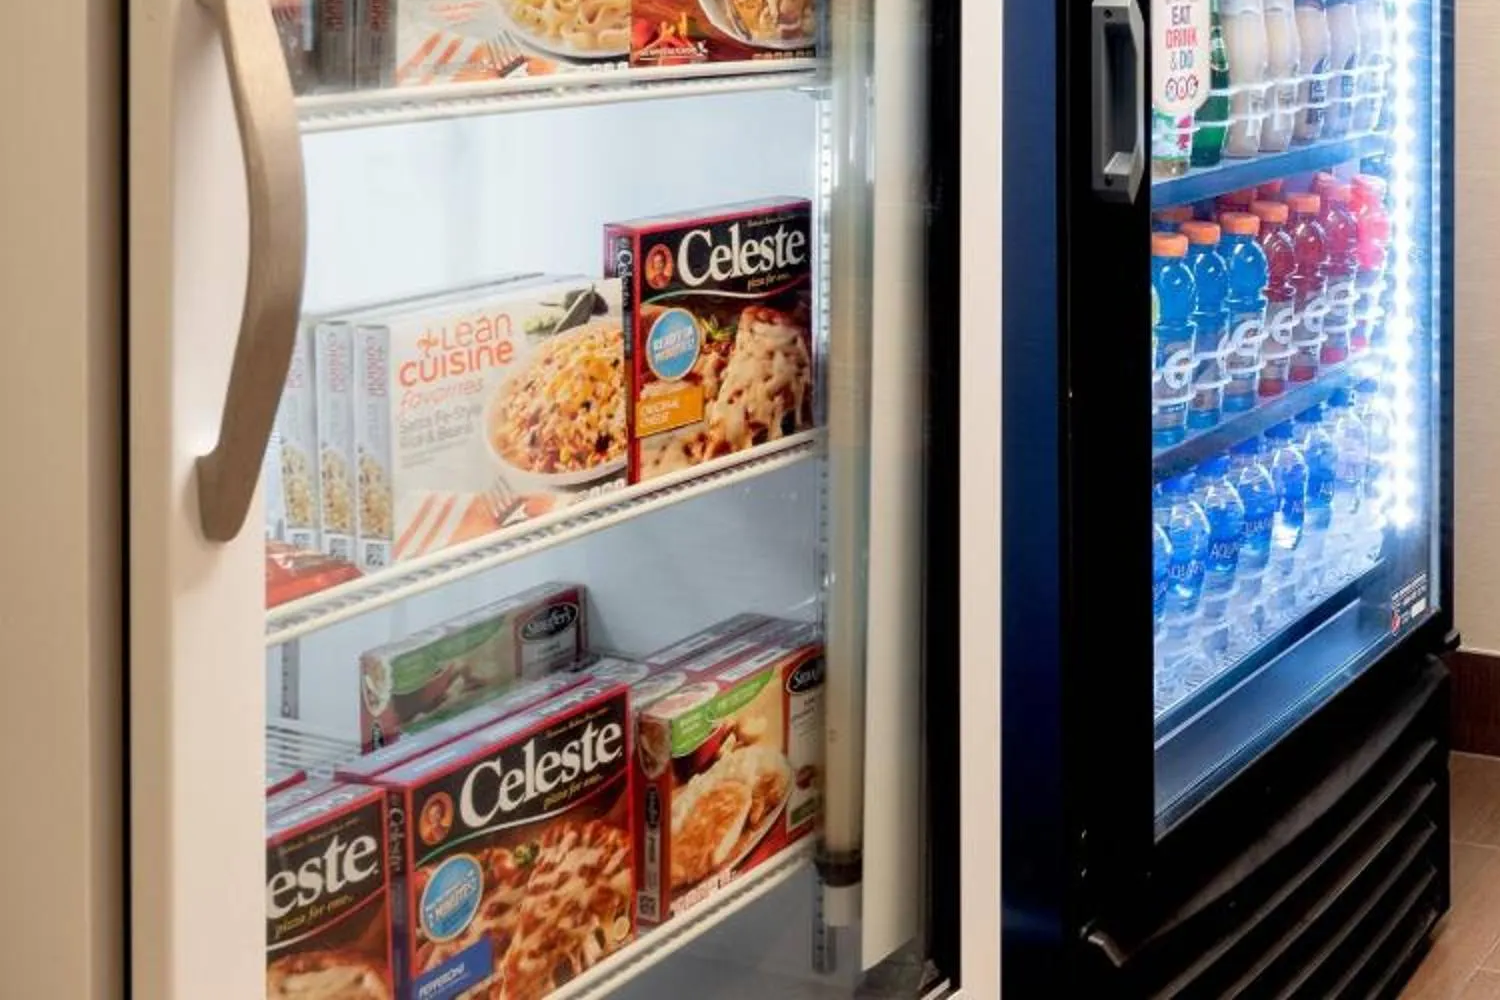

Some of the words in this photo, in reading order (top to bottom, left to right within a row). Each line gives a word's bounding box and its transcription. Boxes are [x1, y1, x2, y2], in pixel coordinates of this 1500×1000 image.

[1171, 5, 1192, 25] EAT
[1165, 28, 1198, 49] DRINK
[677, 221, 807, 287] Celeste
[442, 313, 513, 351] Lean
[460, 721, 623, 828] Celeste
